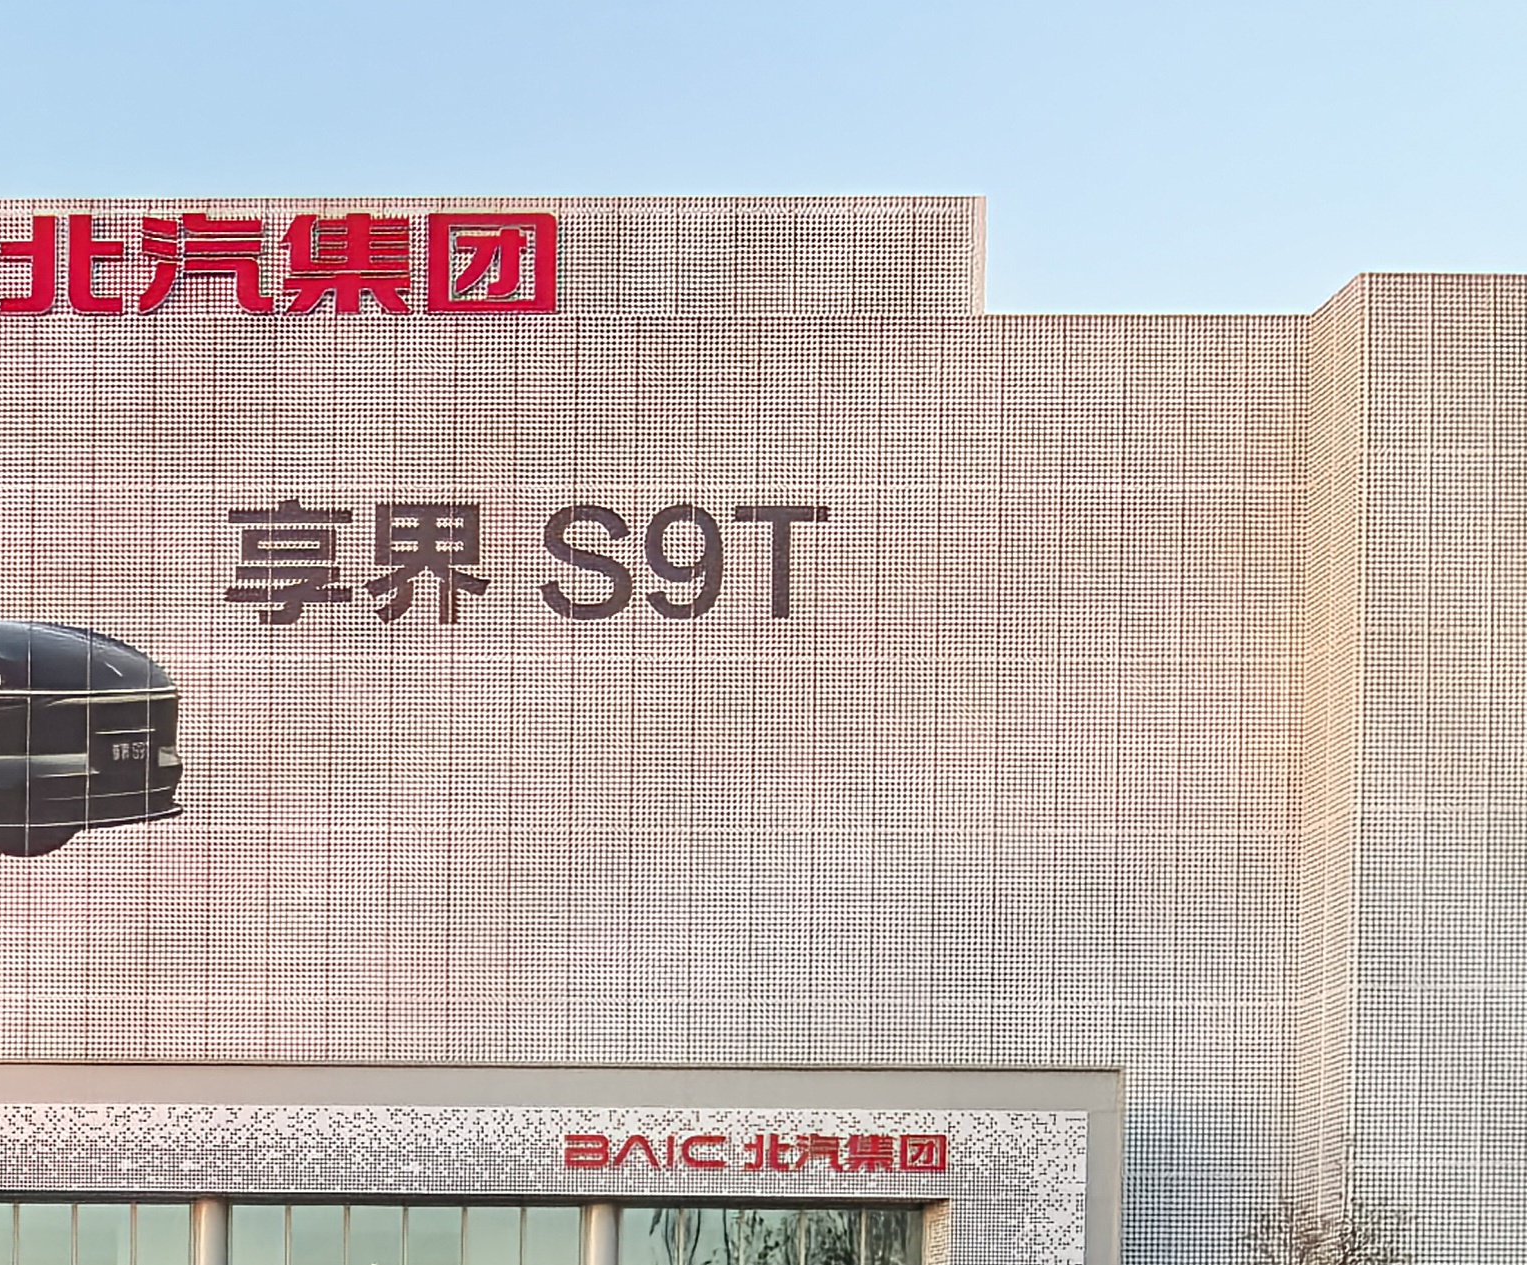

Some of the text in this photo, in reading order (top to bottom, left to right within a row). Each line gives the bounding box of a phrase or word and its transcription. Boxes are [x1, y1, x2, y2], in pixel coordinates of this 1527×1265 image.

[0, 211, 559, 315] 北汽集团
[224, 500, 829, 624] 享界 S9T
[563, 1133, 948, 1172] BAIC 北汽集团
